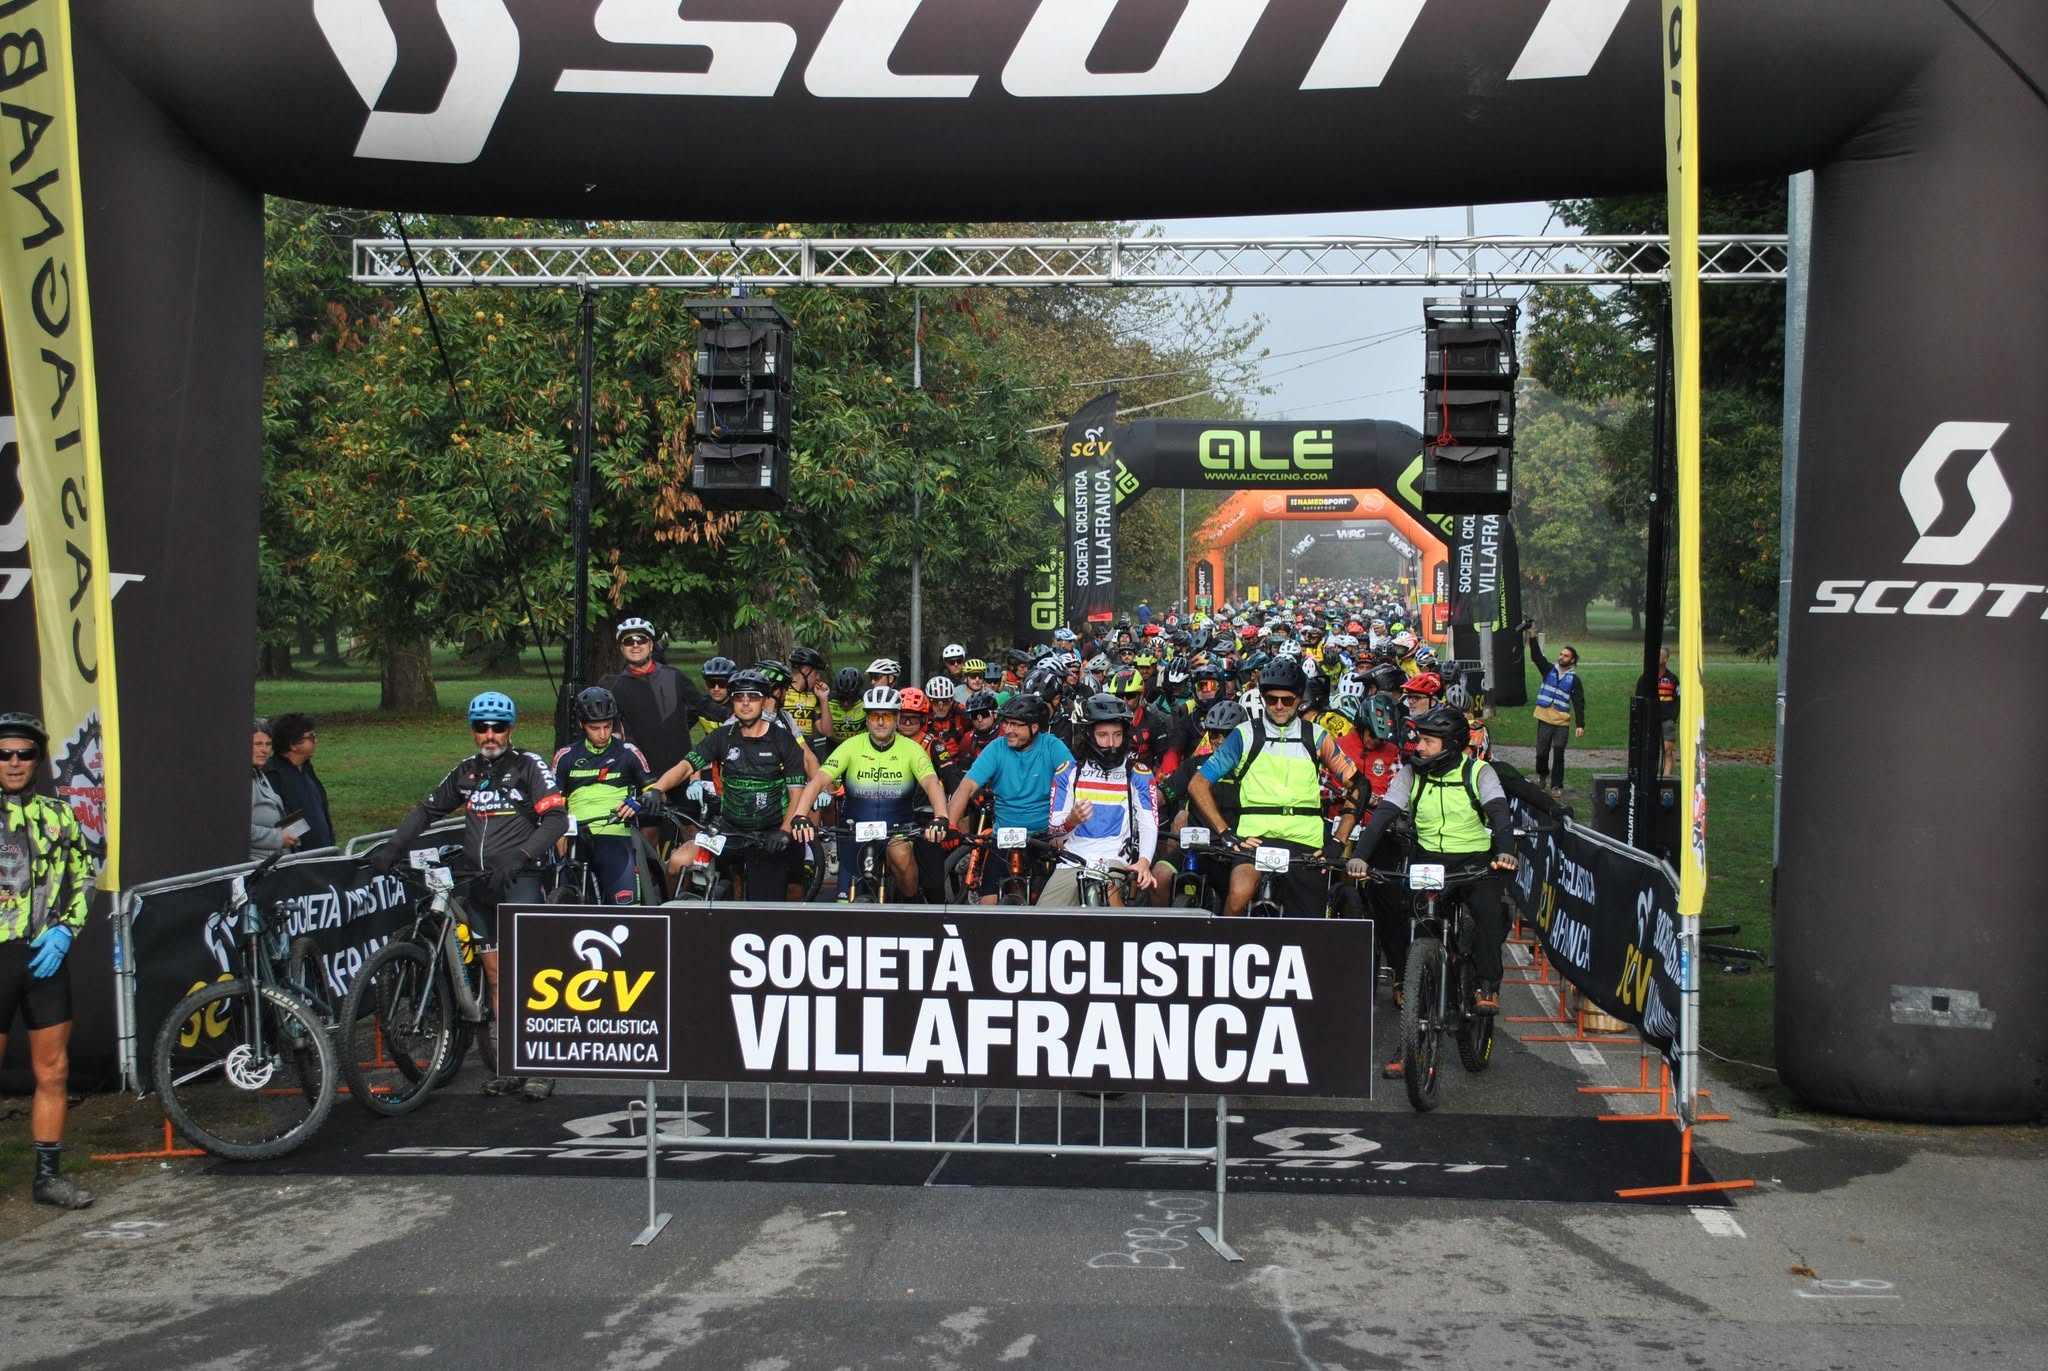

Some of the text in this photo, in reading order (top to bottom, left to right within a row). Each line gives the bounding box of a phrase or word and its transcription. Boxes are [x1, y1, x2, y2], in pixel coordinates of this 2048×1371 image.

[1070, 440, 1112, 457] SCV
[1204, 472, 1328, 481] WWW.ALECYCLING.COM
[1074, 470, 1088, 587] SOCIETÀ CICLISTICA
[1095, 469, 1112, 586] VILLAFRANCA
[1336, 529, 1366, 539] WAG
[1458, 544, 1473, 593] SOCIETÀ
[1808, 580, 2048, 620] SCOT
[1004, 833, 1020, 842] 695
[730, 923, 1313, 1001] SOCIETÀ CICLISTICA
[527, 968, 655, 1012] SCV
[526, 1015, 659, 1035] SOCIETÀ CICLISTICA
[730, 993, 1308, 1085] VILLAFRANCA
[526, 1041, 659, 1062] VILLAFRANCA
